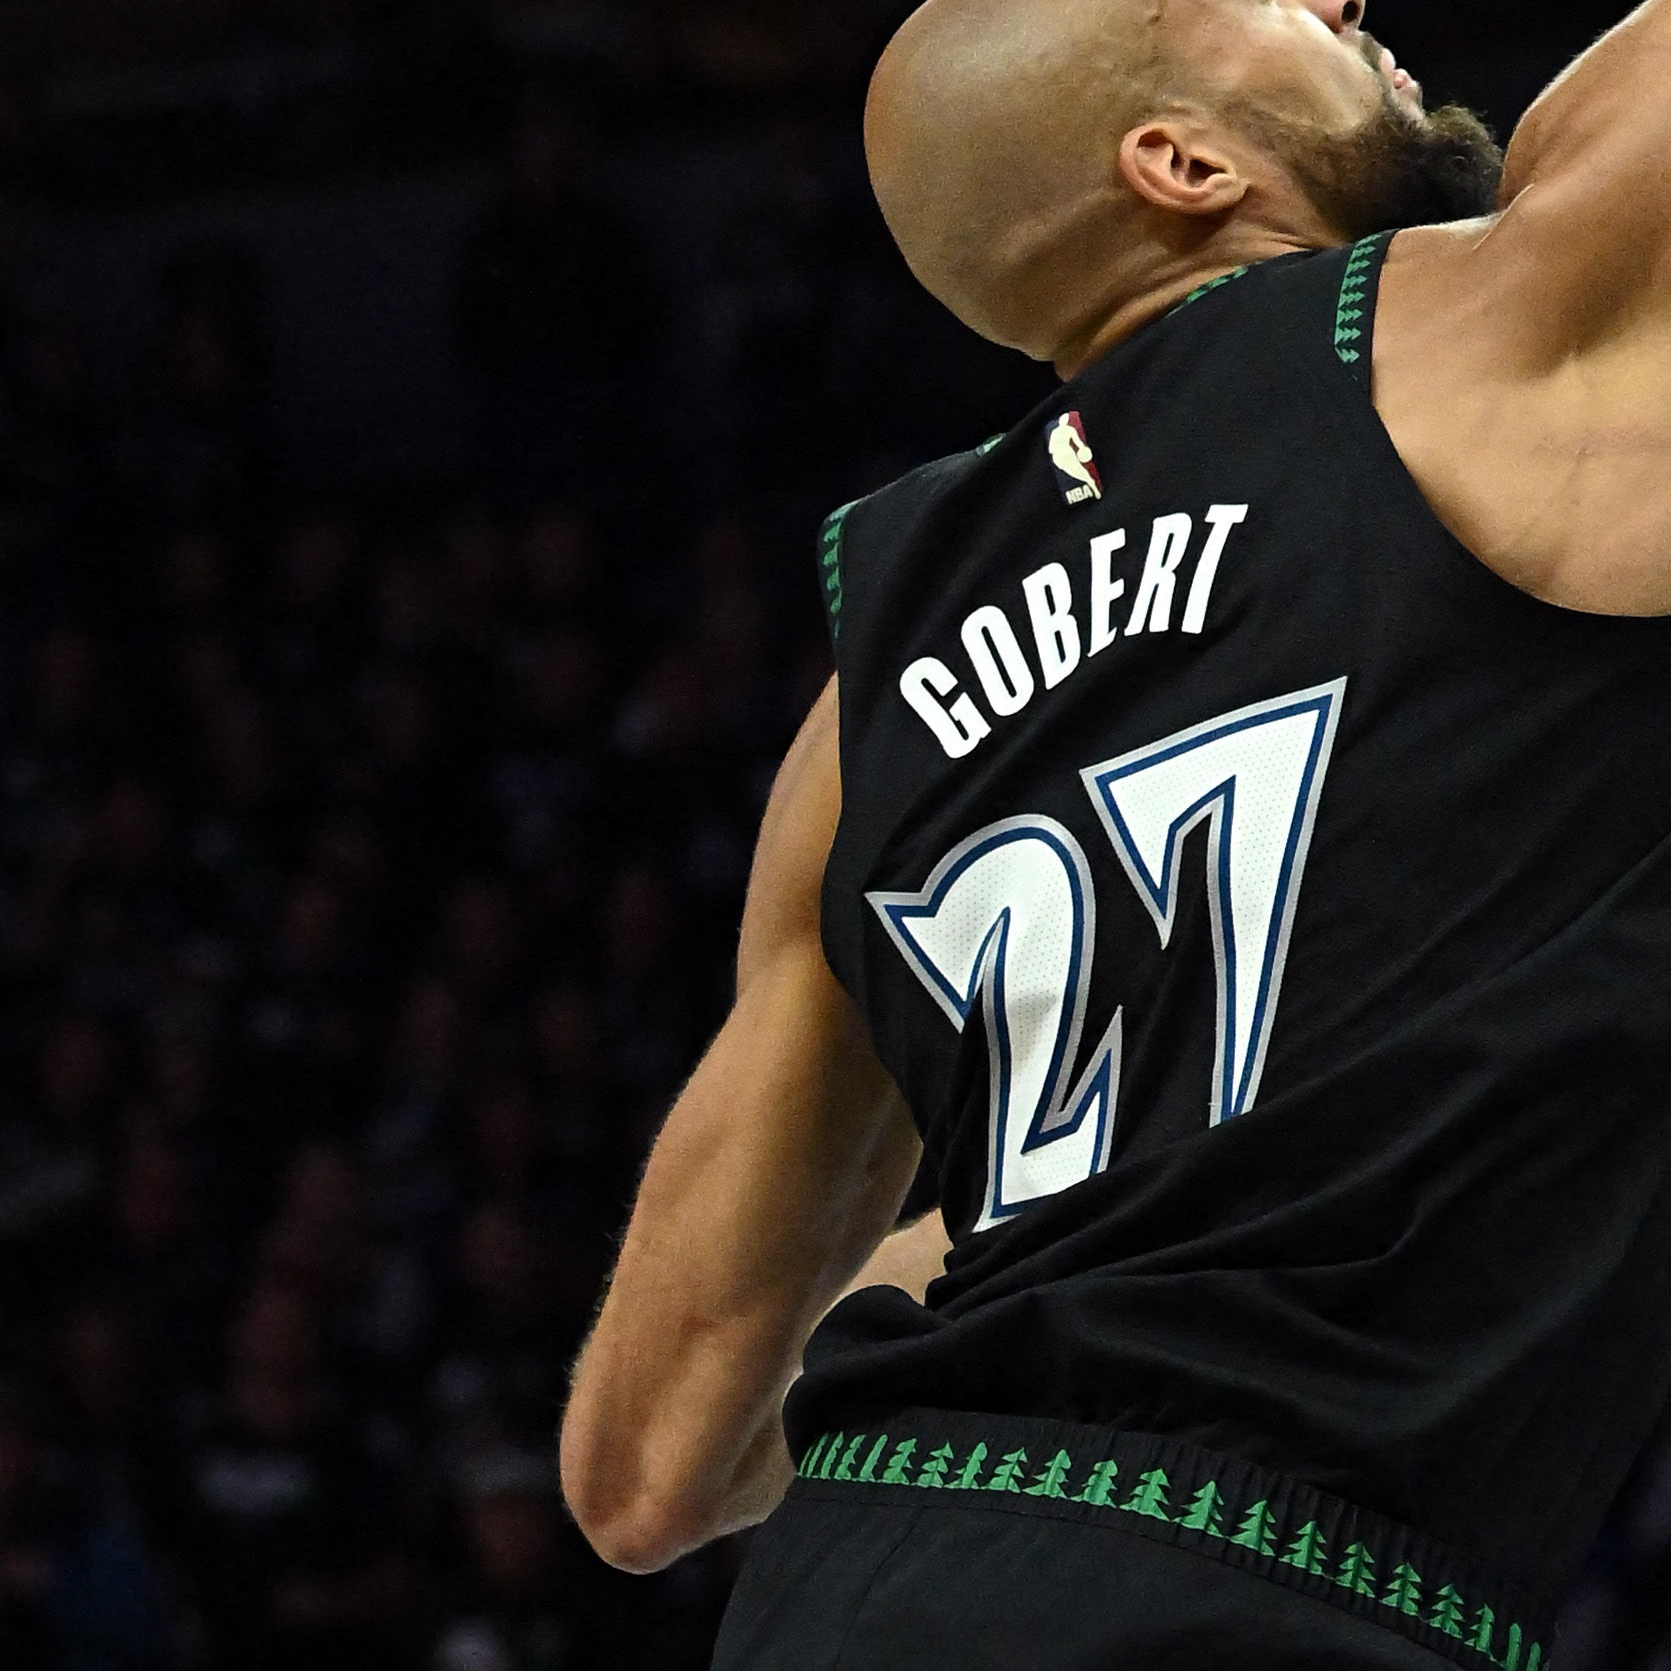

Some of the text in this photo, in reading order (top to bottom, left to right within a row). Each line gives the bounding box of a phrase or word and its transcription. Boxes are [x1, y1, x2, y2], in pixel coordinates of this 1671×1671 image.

[1064, 483, 1094, 505] NBA
[899, 503, 1249, 759] GOBERT
[866, 675, 1347, 1233] 27
